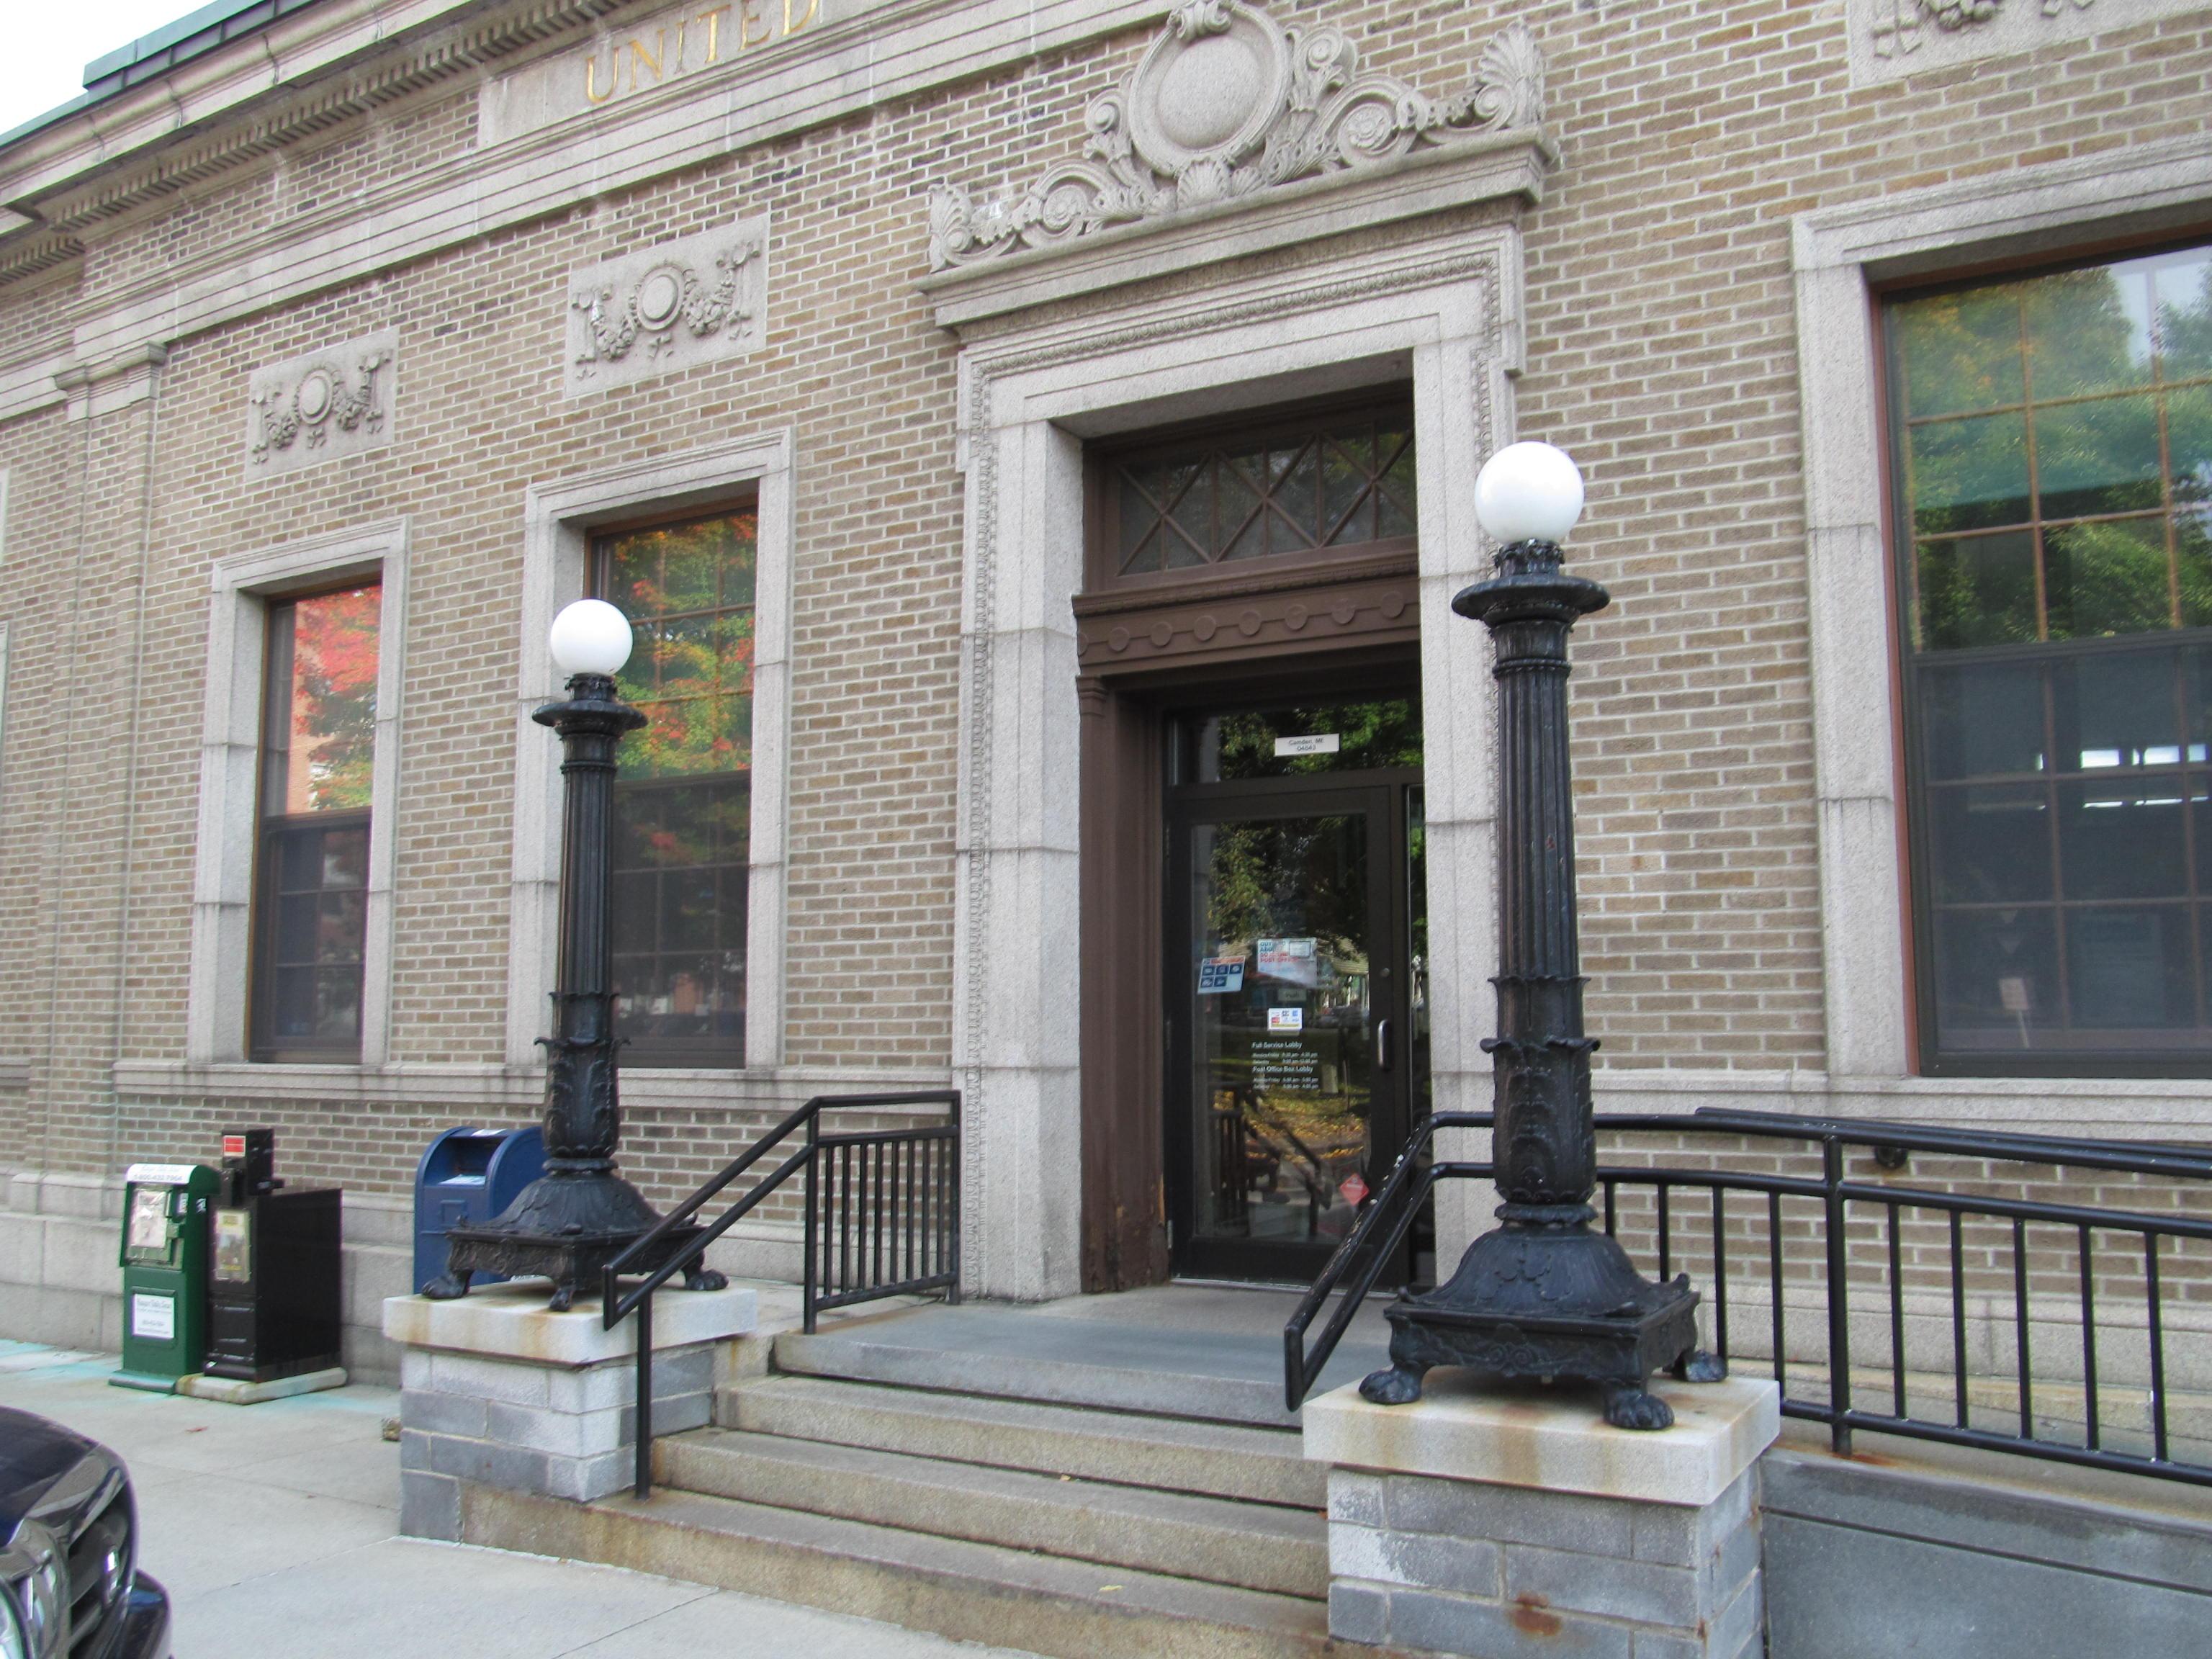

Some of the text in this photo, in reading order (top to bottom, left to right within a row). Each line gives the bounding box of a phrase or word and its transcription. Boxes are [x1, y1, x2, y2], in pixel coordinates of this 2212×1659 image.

[585, 0, 819, 104] UNITED
[1285, 1041, 1303, 1050] Lobby
[1296, 1066, 1314, 1074] Lobby
